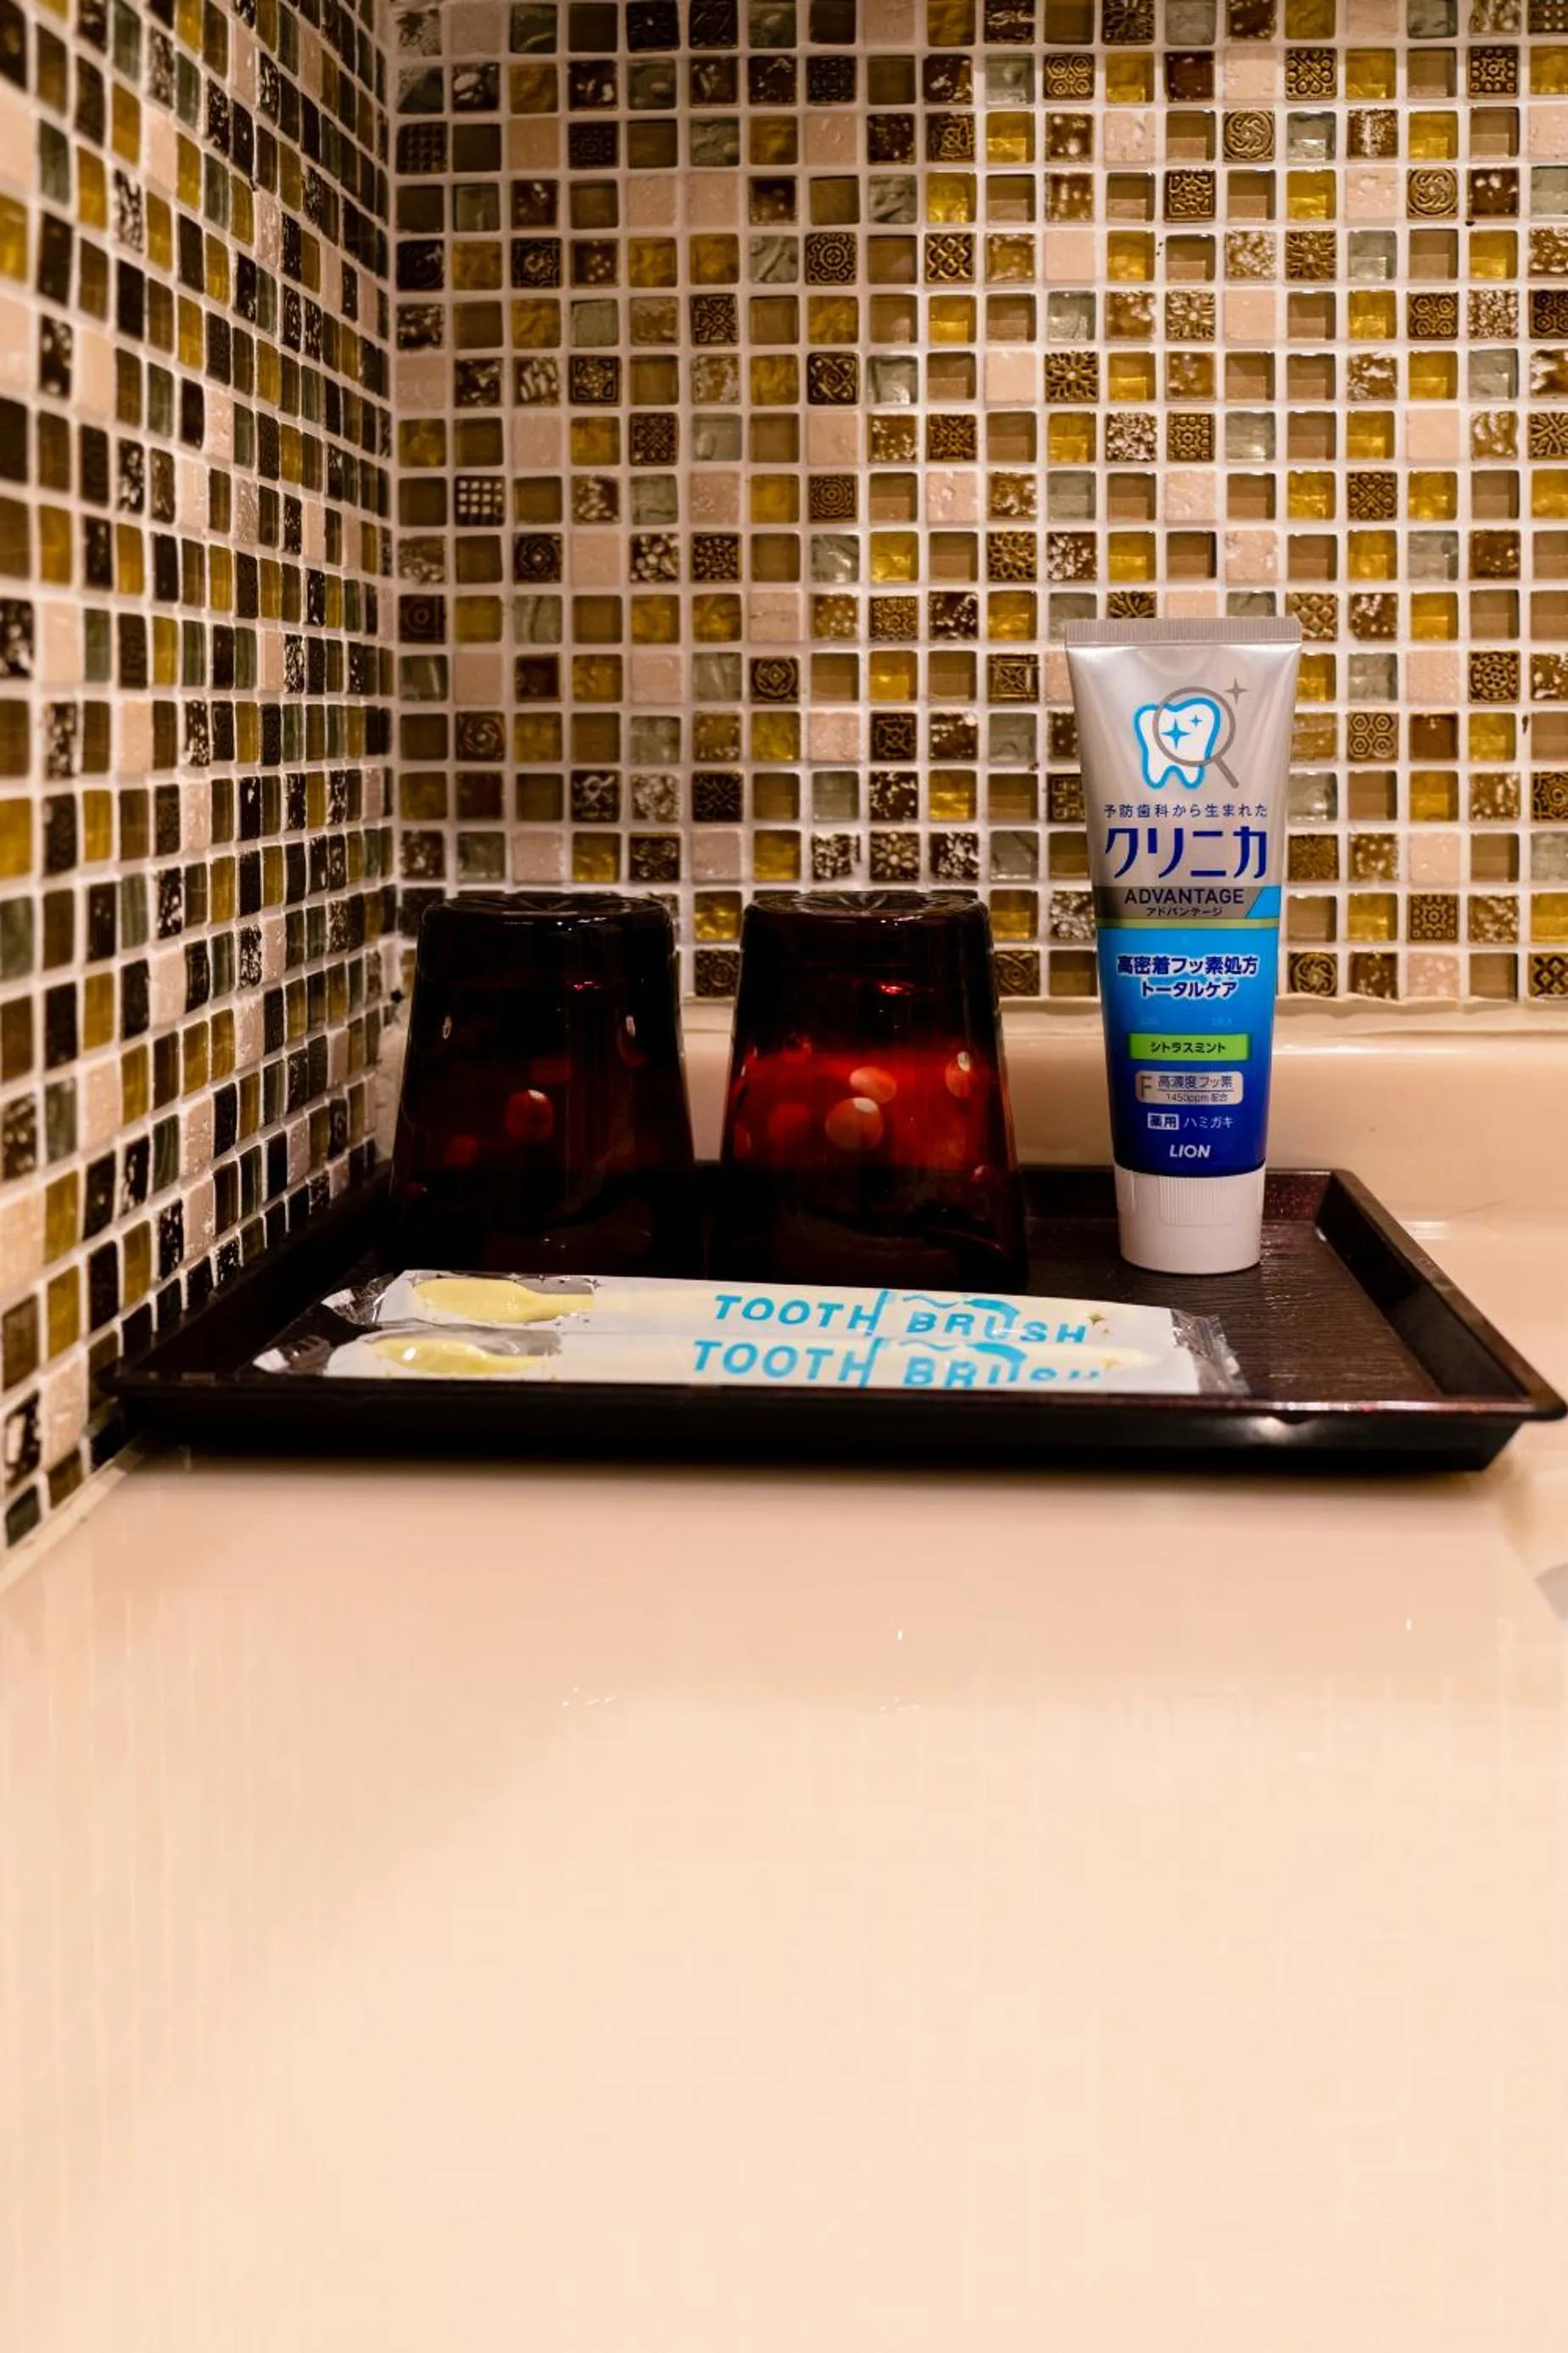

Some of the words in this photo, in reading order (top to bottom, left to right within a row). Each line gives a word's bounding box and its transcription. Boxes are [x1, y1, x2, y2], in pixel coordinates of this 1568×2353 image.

[1103, 803, 1269, 819] 予防歯科から生まれた
[1104, 825, 1268, 880] クリニカ
[1124, 888, 1245, 904] ADVANTAGE
[1147, 906, 1224, 917] アドバンテージ
[1117, 955, 1258, 975] 高密着フッ素処方
[1141, 981, 1238, 998] トータルケア
[1150, 1041, 1226, 1054] シトラスミント
[1158, 1075, 1233, 1089] 高濃度フッ素
[1169, 1143, 1212, 1159] LION
[714, 1289, 889, 1336] TOOTH
[906, 1308, 1087, 1343] BRUSH
[693, 1337, 884, 1389] TOOTH
